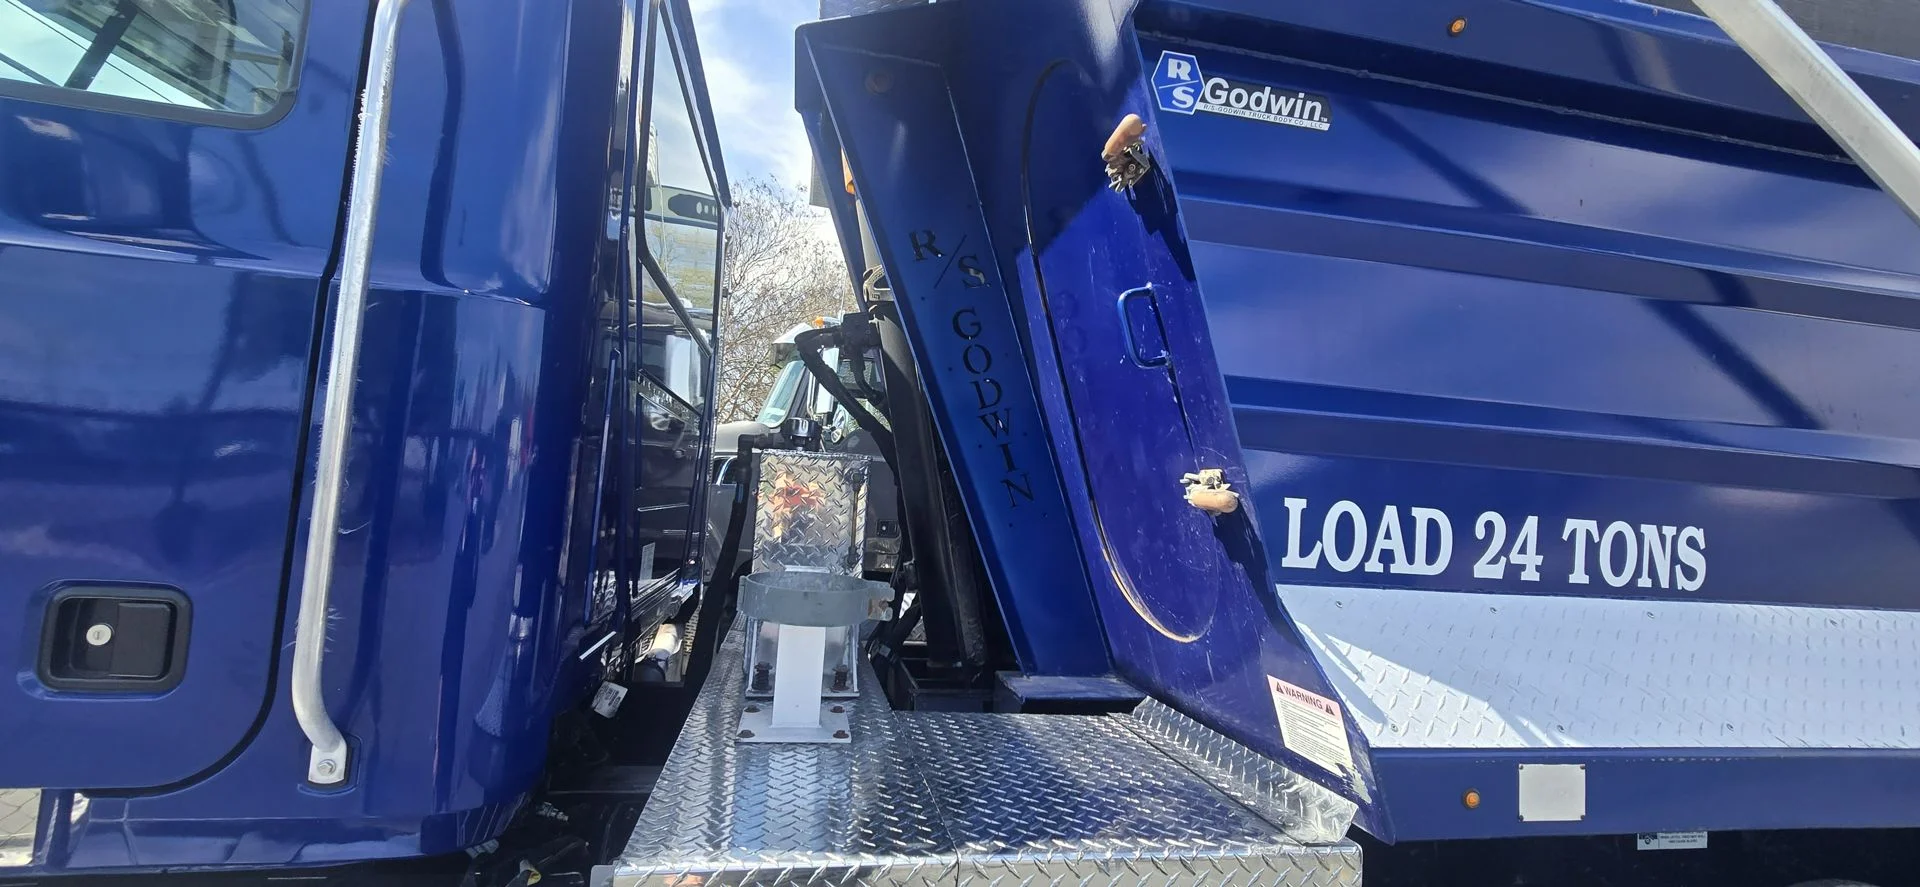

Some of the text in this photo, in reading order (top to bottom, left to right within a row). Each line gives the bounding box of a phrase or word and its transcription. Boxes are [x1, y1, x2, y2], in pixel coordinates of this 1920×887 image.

[1204, 77, 1321, 121] Godwin
[1217, 105, 1246, 116] GODWIN
[1248, 111, 1271, 120] TRUCK
[1273, 115, 1293, 124] BODY
[1310, 121, 1323, 129] LLC
[952, 306, 1035, 507] GODWIN
[1281, 497, 1707, 592] LOAD 24 TONS
[1283, 686, 1323, 710] WARNING
